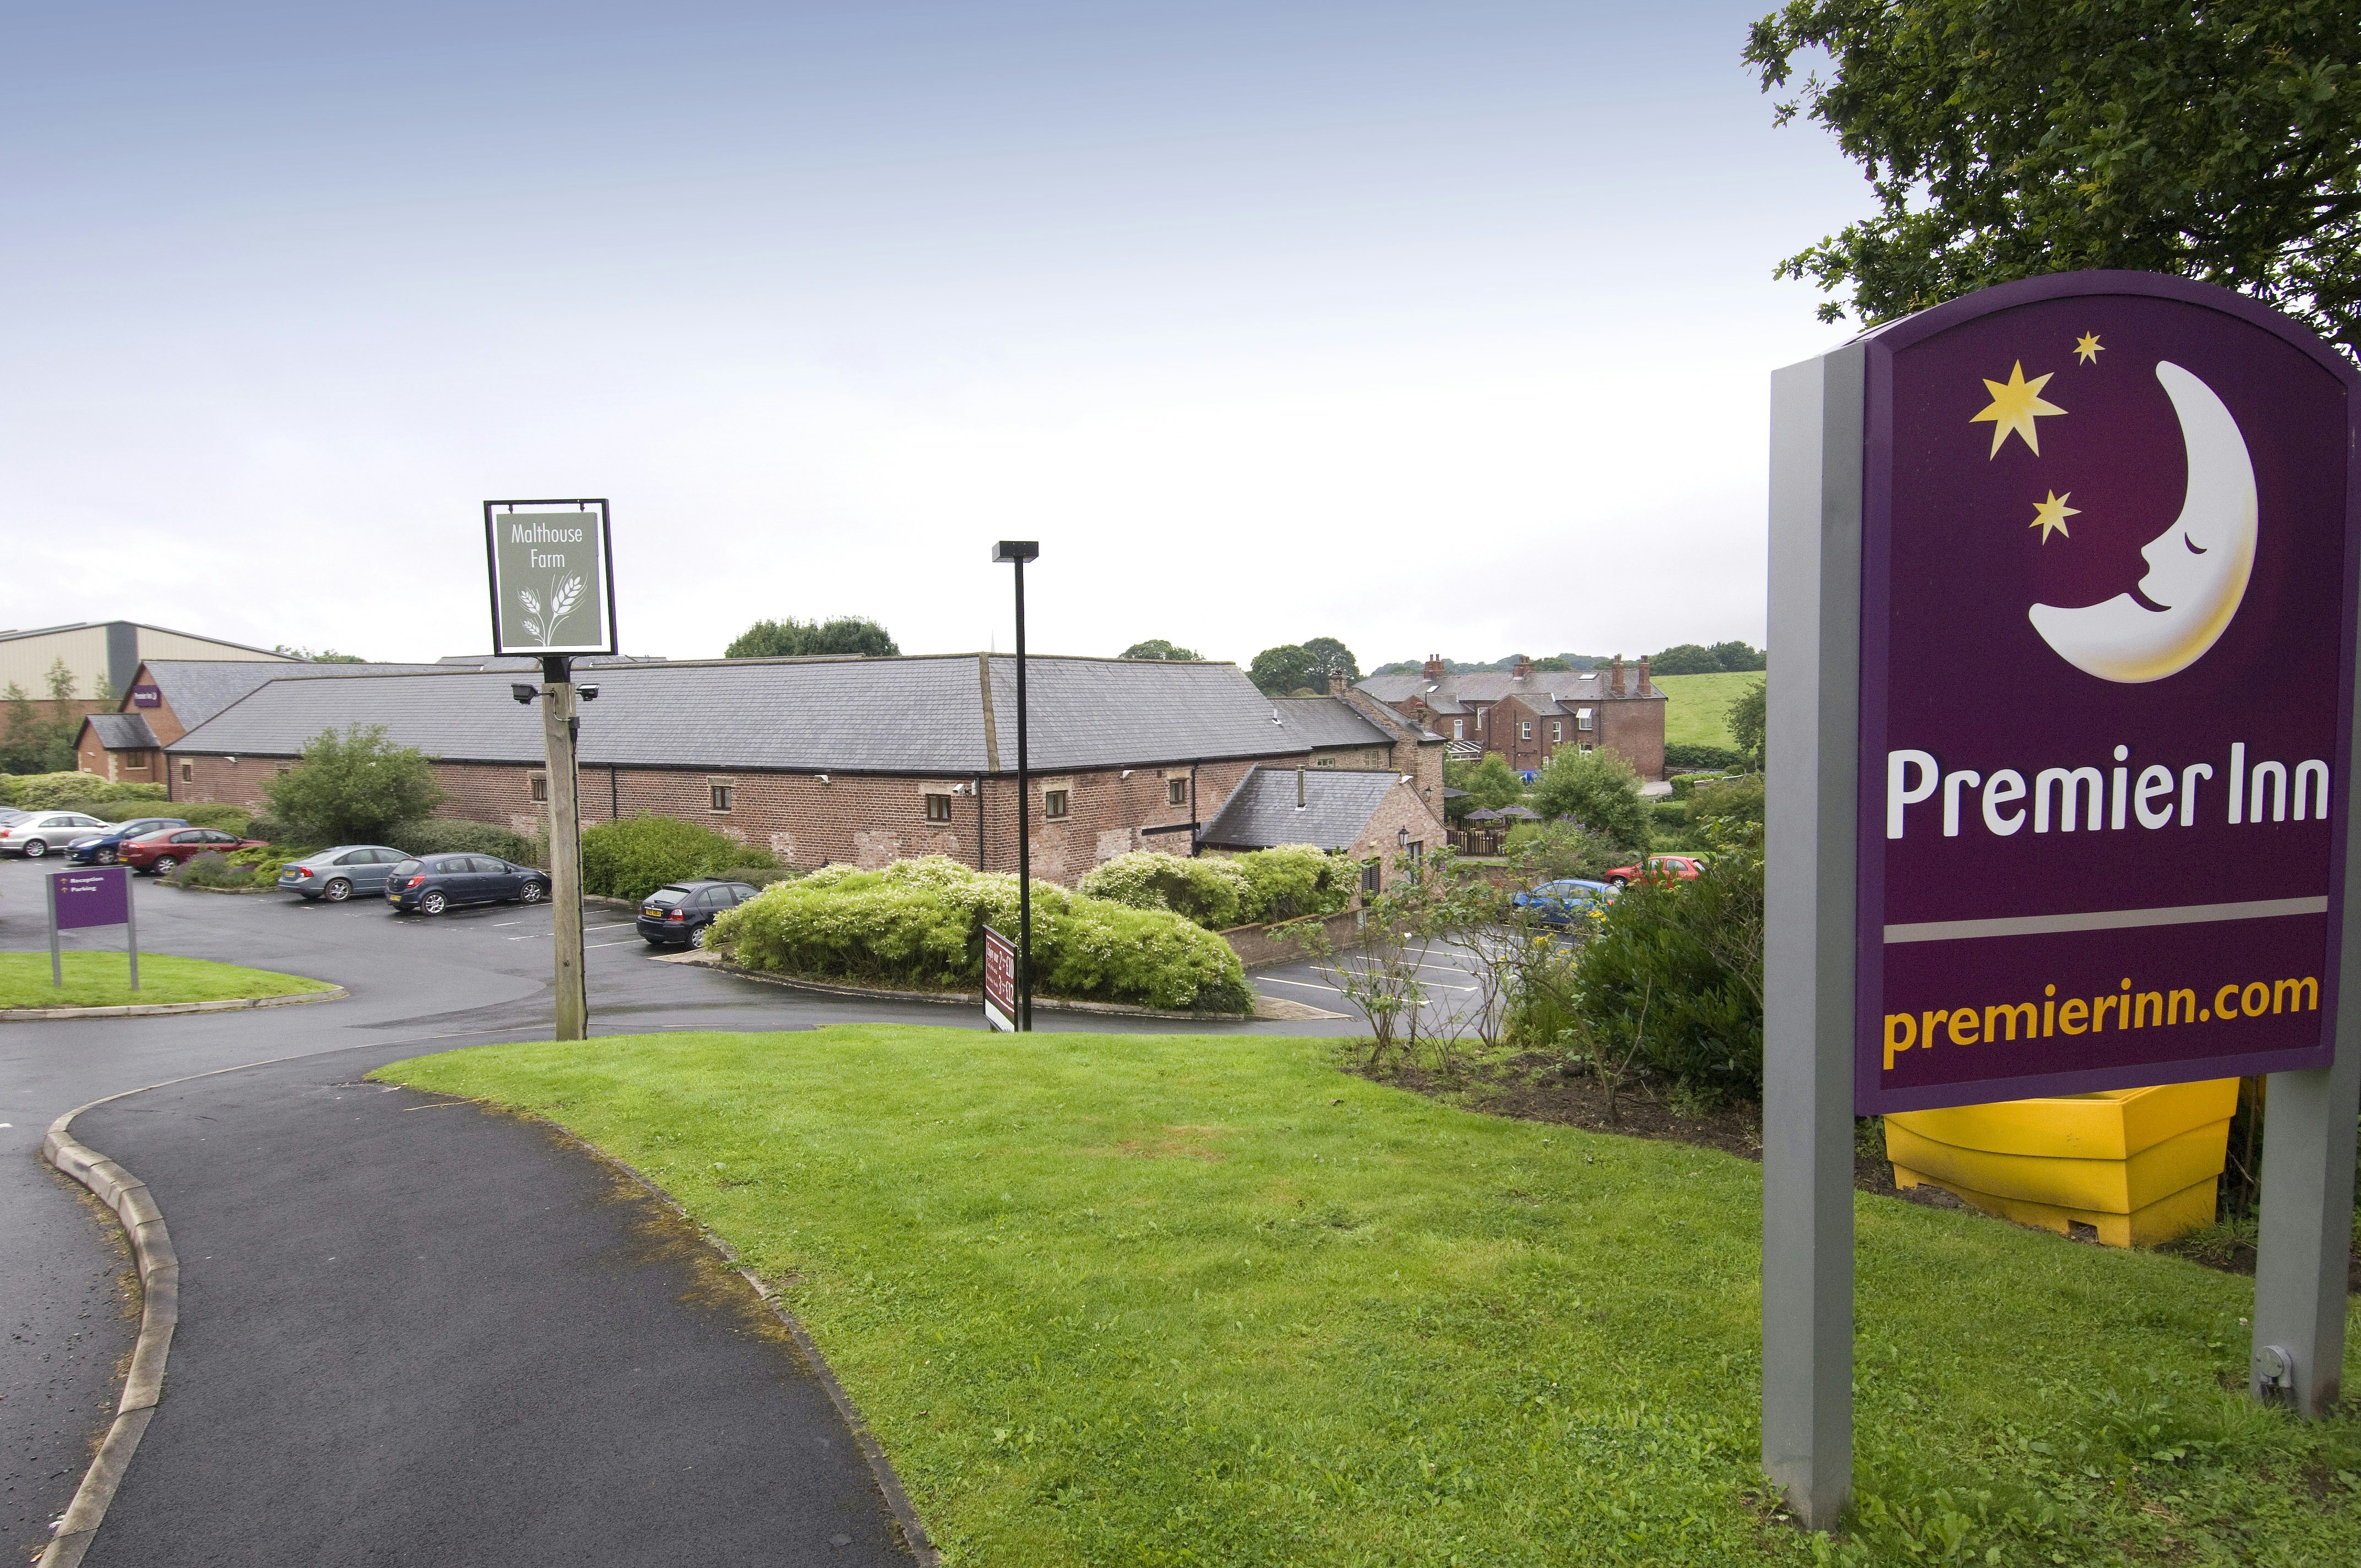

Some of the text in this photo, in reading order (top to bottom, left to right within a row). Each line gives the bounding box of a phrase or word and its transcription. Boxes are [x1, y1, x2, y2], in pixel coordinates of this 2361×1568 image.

[511, 522, 583, 543] Malthouse
[530, 549, 565, 568] Farm
[1886, 742, 2329, 839] Premier Inn
[999, 950, 1002, 971] 2
[998, 974, 1002, 995] 3
[1883, 975, 2318, 1070] premierinn.com
